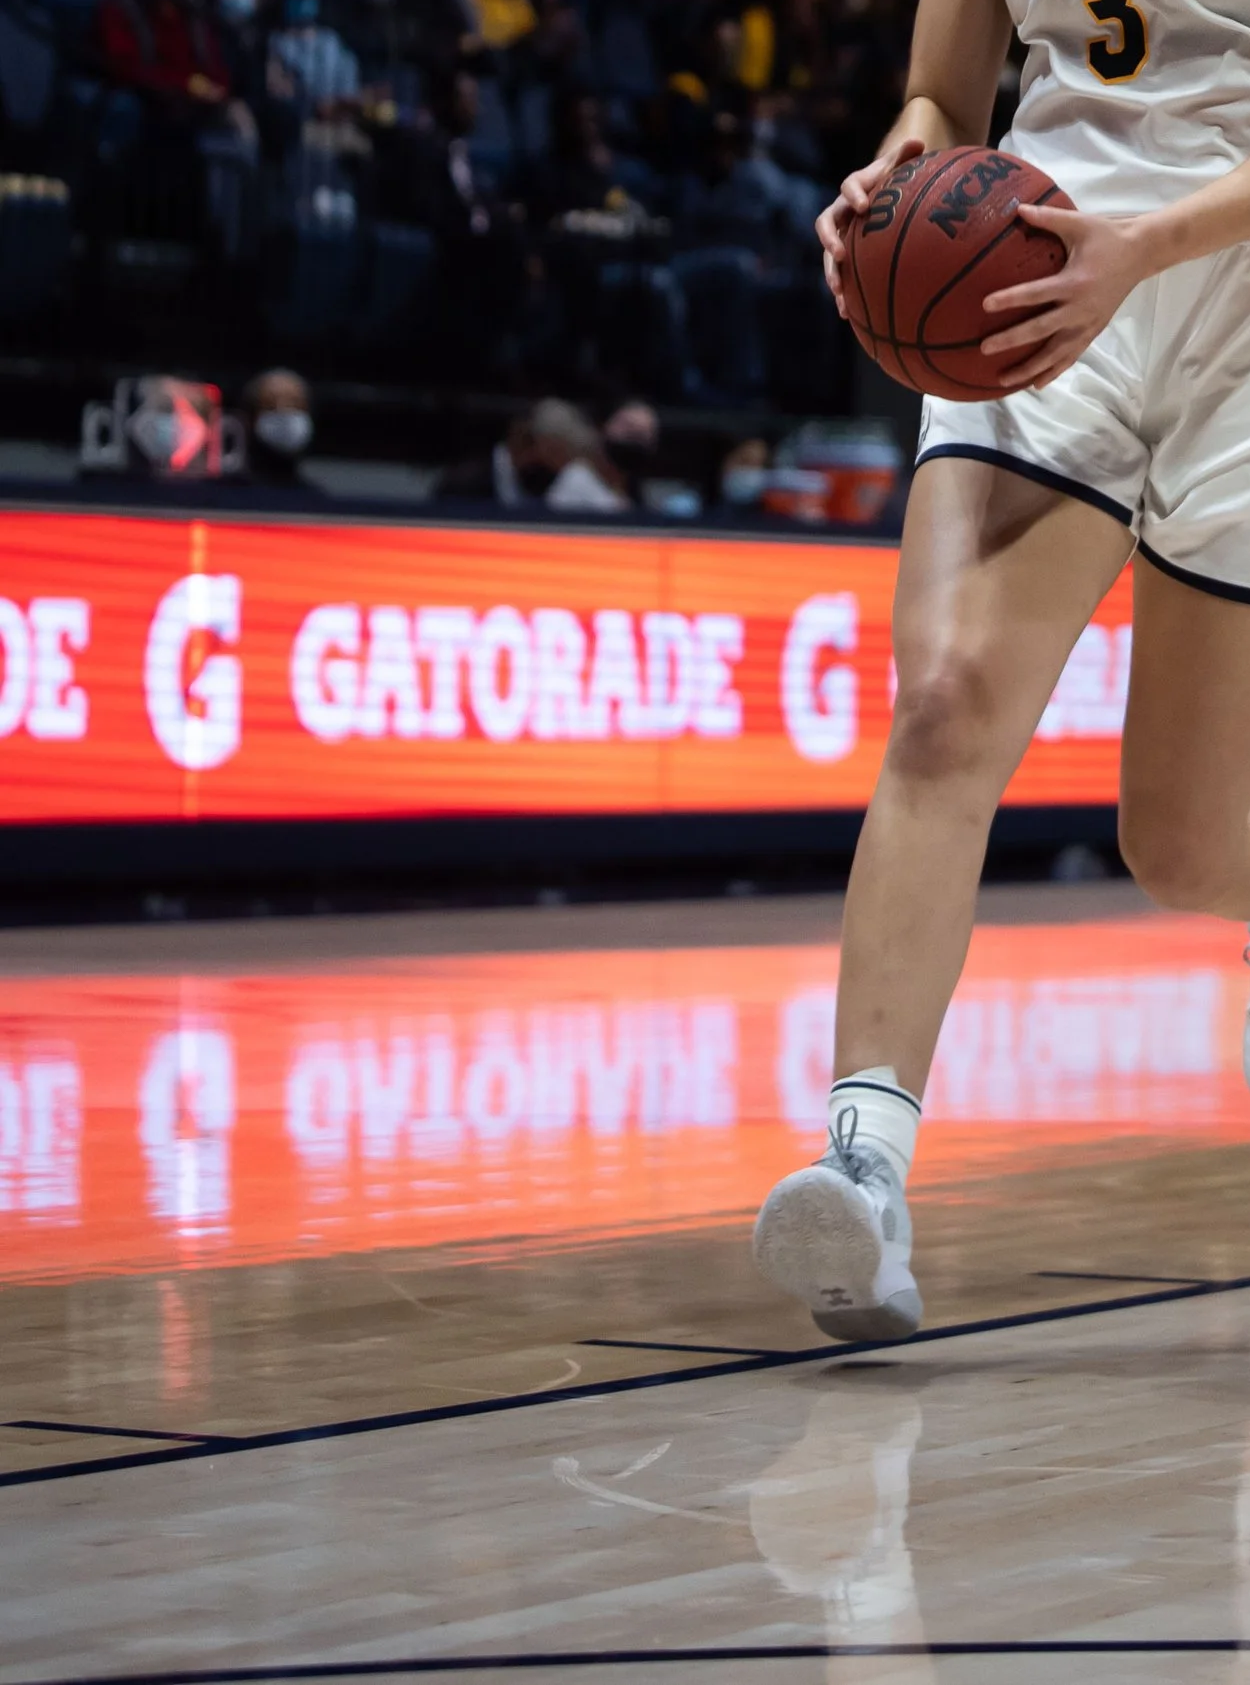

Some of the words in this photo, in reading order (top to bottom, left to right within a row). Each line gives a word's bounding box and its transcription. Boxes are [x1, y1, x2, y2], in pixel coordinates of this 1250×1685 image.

[928, 154, 1022, 239] NCAA
[144, 573, 242, 770] G
[289, 602, 744, 743] GATORADE
[781, 592, 858, 763] G
